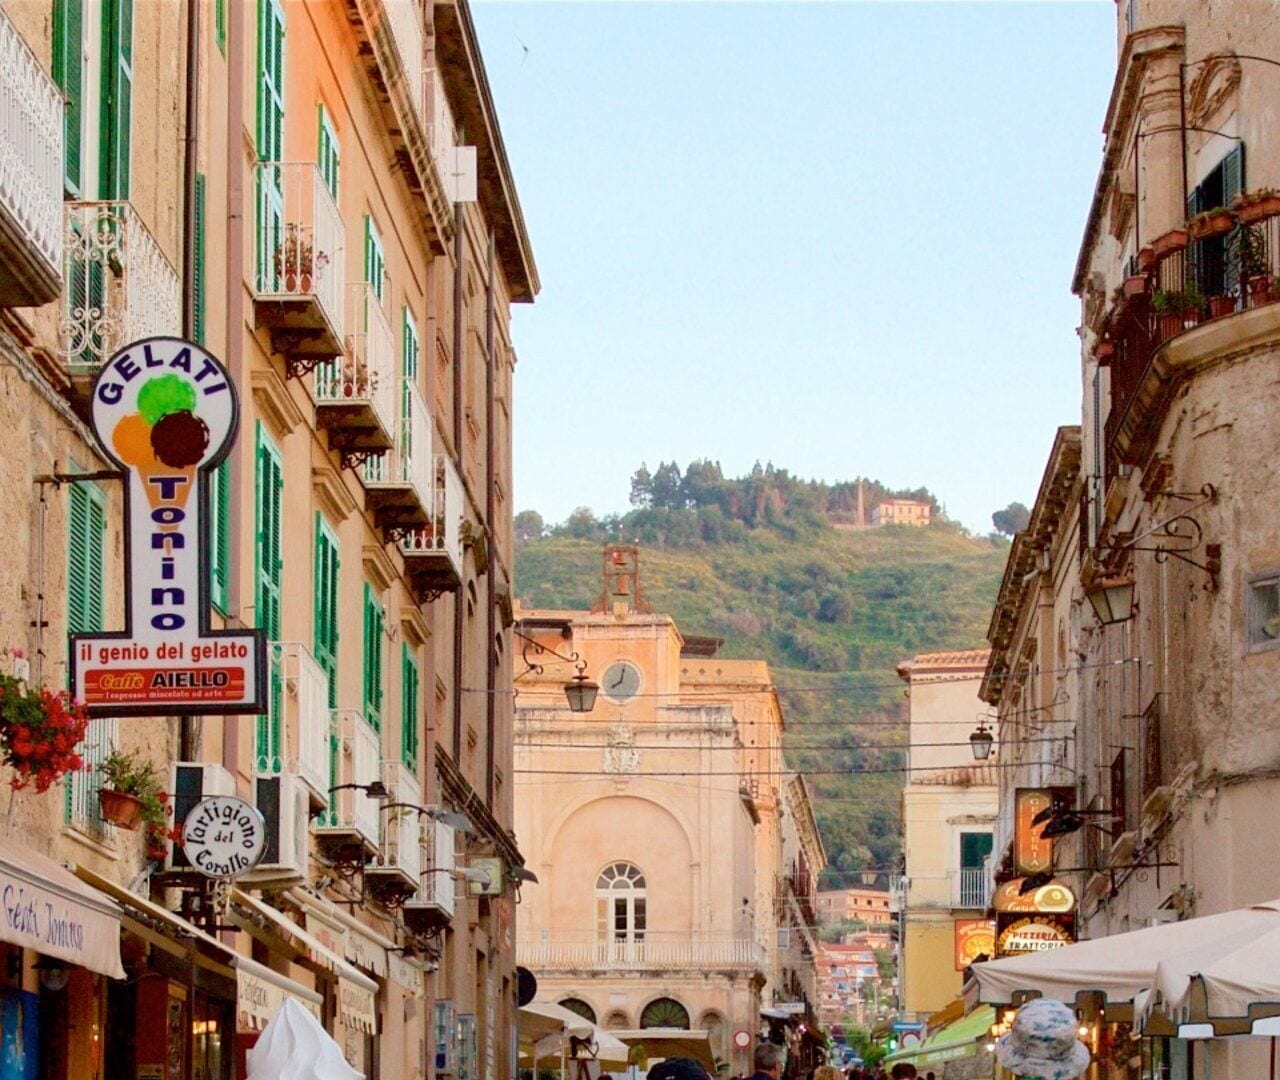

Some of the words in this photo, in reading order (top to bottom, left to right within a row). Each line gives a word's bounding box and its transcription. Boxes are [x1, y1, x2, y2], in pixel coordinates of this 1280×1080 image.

[98, 344, 227, 405] GELATI
[149, 476, 187, 631] Tonino
[81, 644, 92, 661] il
[100, 643, 149, 664] genio
[156, 642, 183, 660] del
[191, 641, 248, 663] gelato
[151, 670, 229, 689] AIELLO
[214, 830, 234, 843] del
[195, 849, 249, 875] Corallo
[1012, 932, 1058, 941] PIZZERIA
